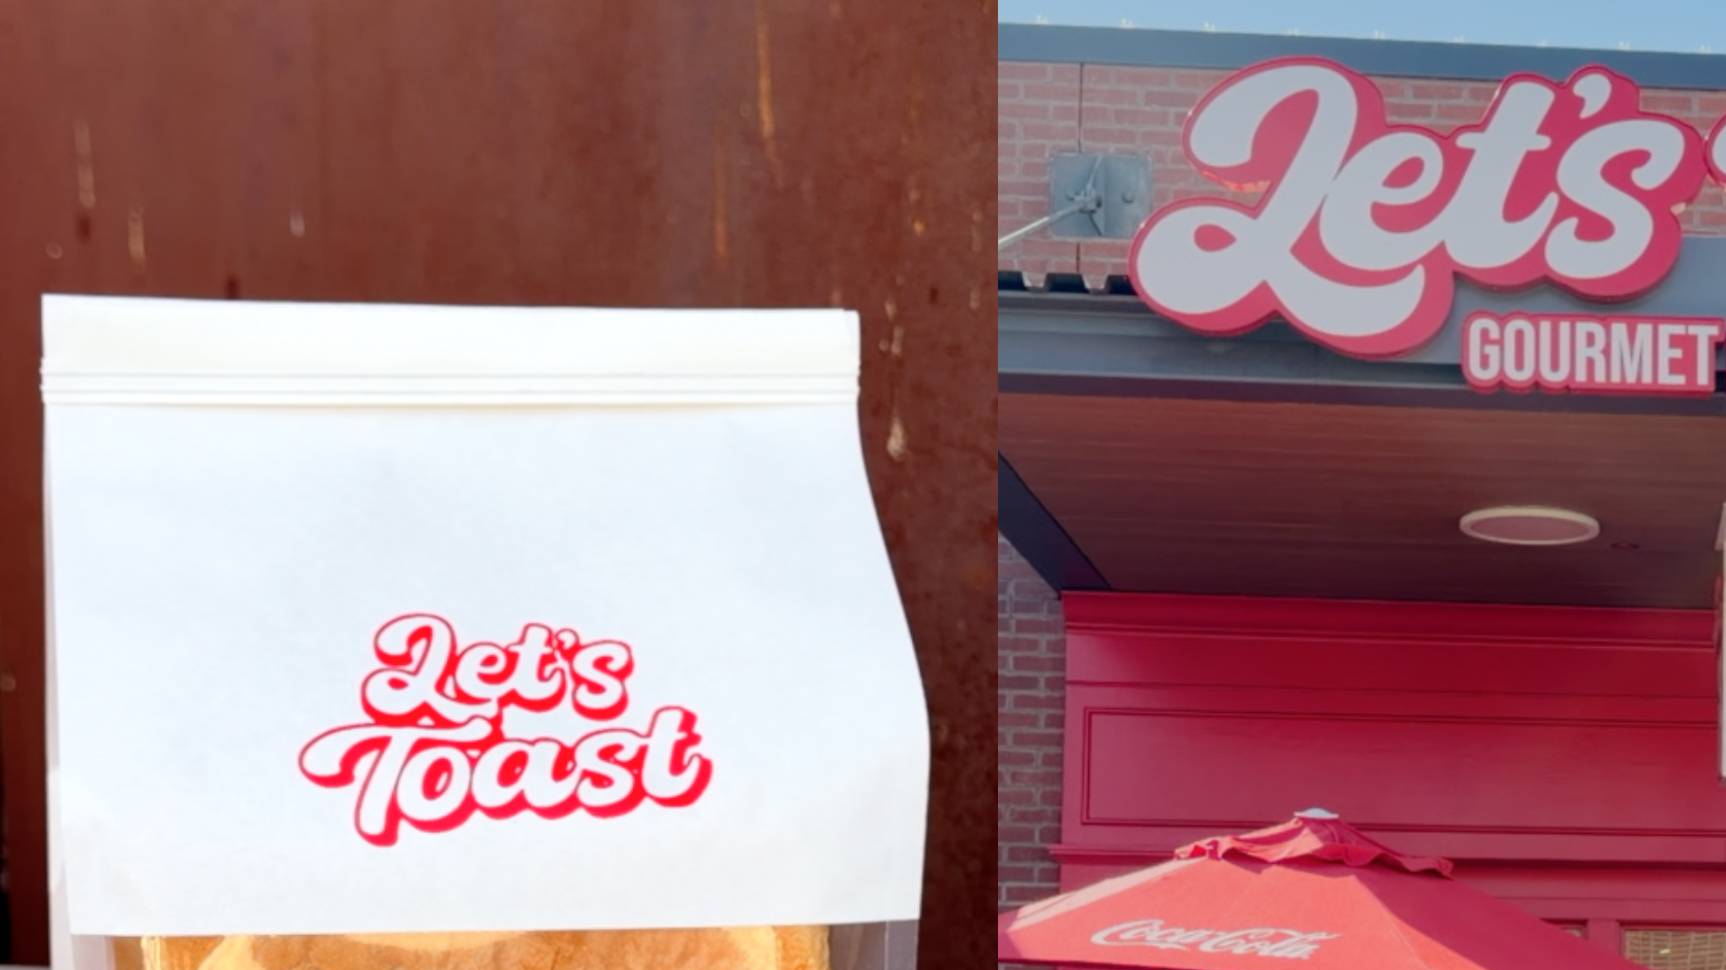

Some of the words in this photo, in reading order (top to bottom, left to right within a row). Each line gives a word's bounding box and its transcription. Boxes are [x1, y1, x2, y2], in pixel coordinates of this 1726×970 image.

[1127, 62, 1690, 340] Let's
[1467, 317, 1720, 387] GOURMET
[360, 612, 635, 726] Let's
[298, 705, 714, 848] Toast
[1090, 919, 1343, 960] Coca-Cola
